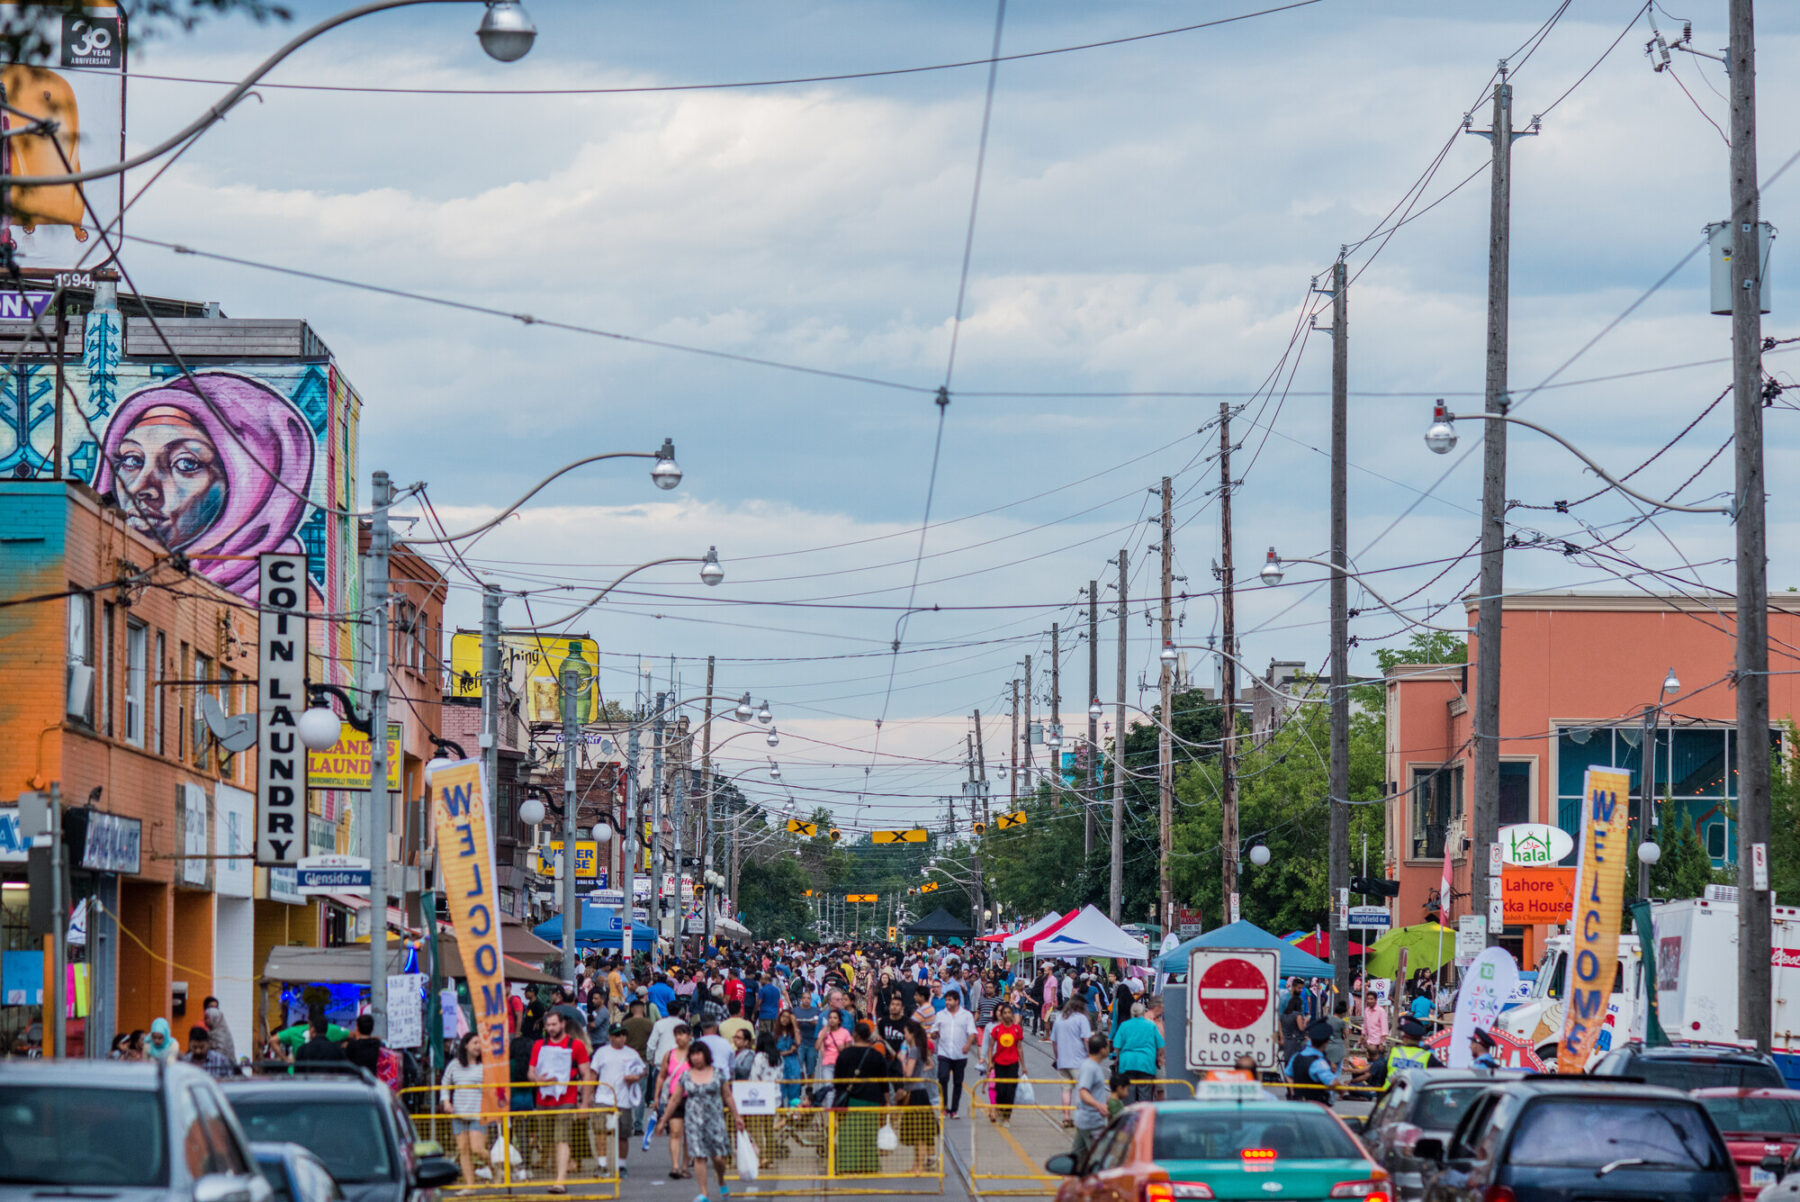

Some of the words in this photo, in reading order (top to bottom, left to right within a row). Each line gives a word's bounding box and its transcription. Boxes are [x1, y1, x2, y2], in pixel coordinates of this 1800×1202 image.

[268, 560, 297, 662] COIN
[268, 678, 297, 861] LAUNDRY
[308, 757, 396, 776] LAUNDY
[1512, 838, 1551, 862] halal
[304, 872, 350, 885] Glenside
[1506, 878, 1554, 891] Lahore
[1529, 900, 1573, 912] House
[1352, 915, 1379, 924] Highfield
[1567, 789, 1616, 1055] WELCOME
[1209, 1032, 1256, 1045] ROAD
